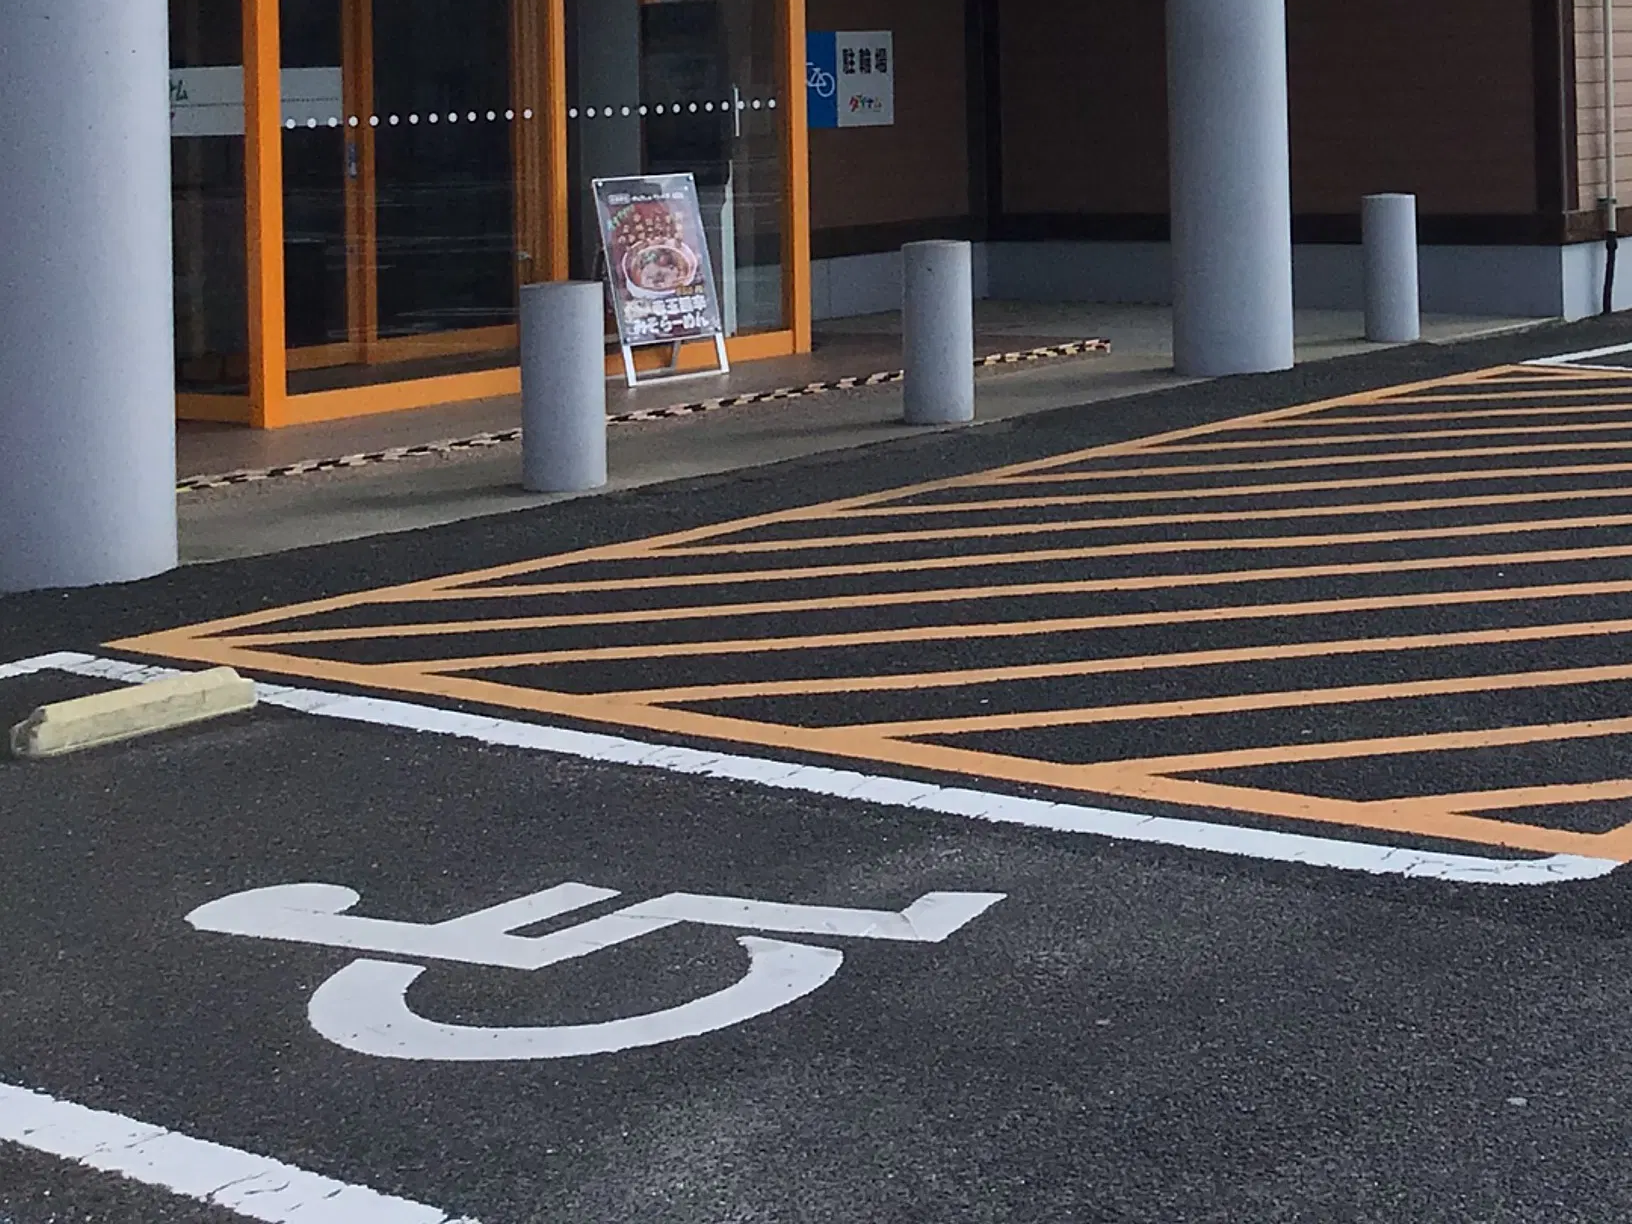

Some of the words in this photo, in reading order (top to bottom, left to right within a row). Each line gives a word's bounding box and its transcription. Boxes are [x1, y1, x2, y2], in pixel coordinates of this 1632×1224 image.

[842, 48, 887, 74] 駐輪場
[633, 311, 709, 334] みそらーめん
